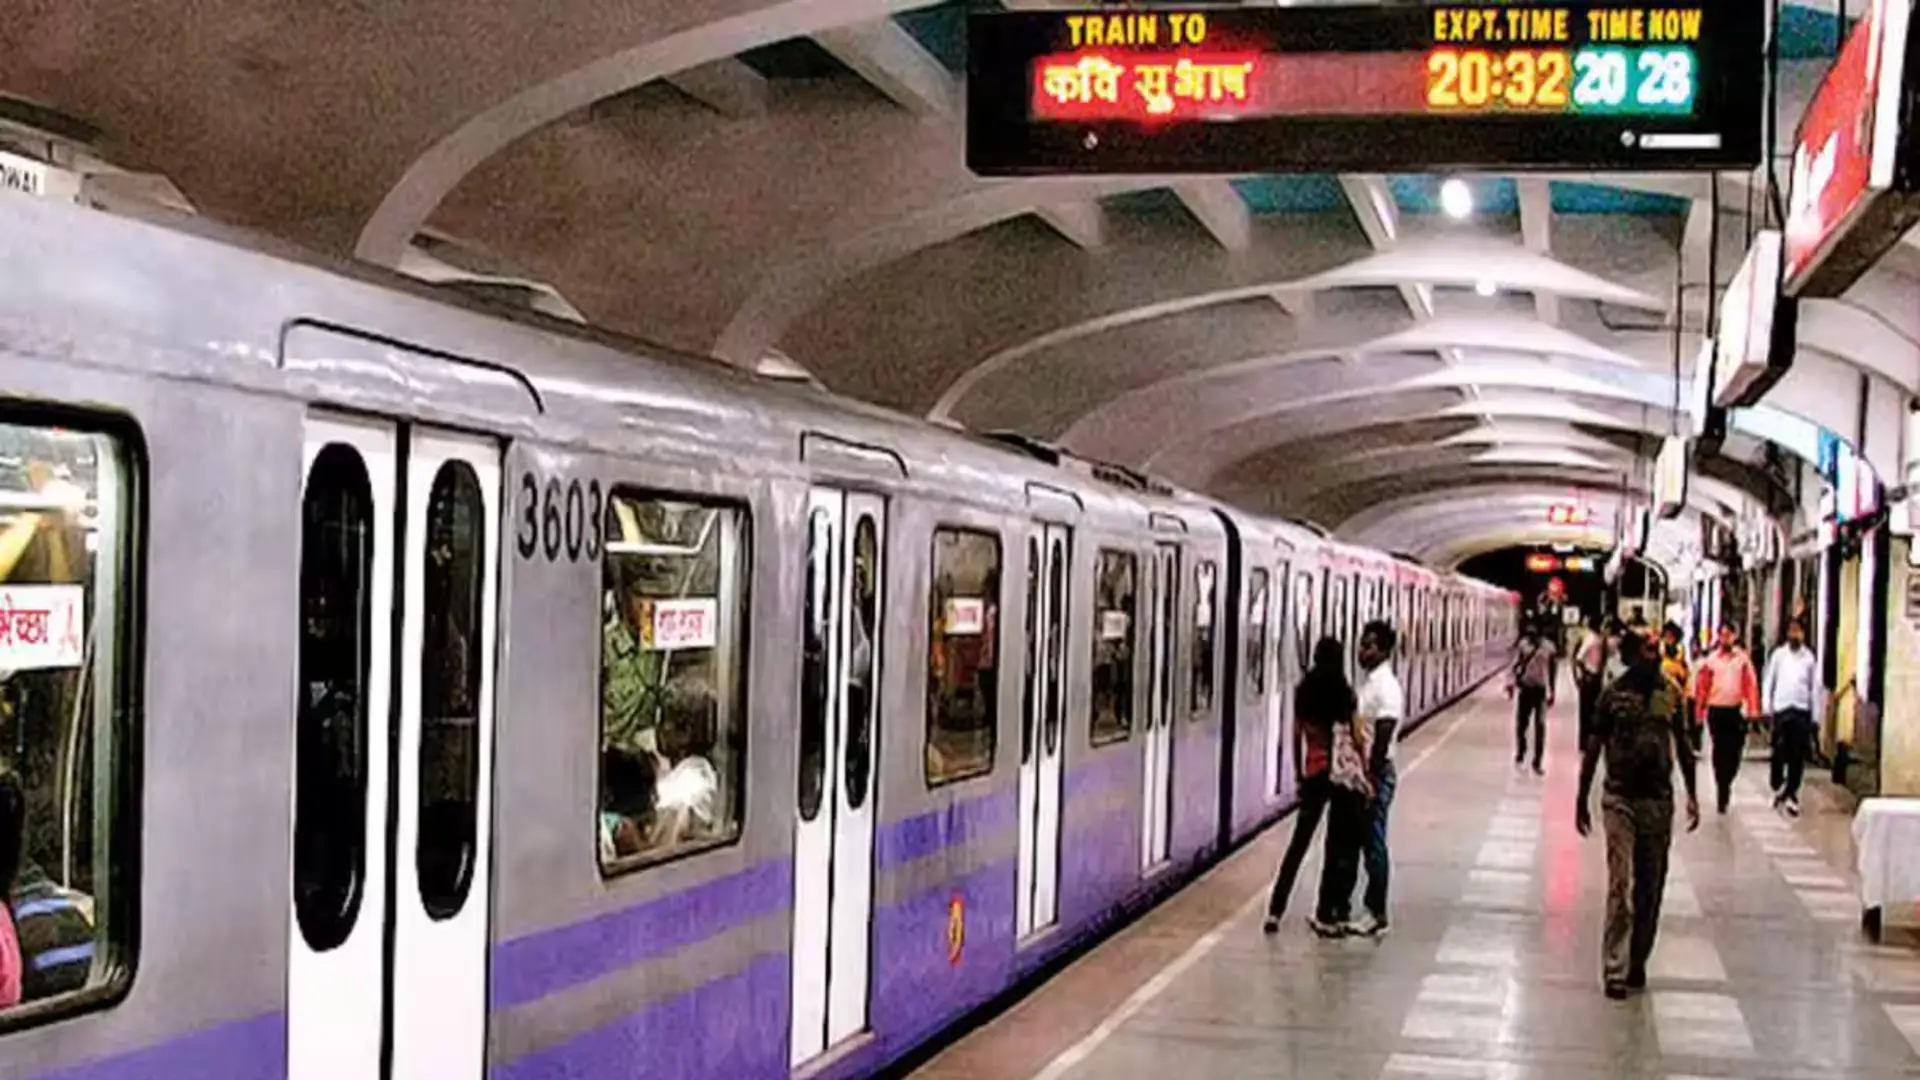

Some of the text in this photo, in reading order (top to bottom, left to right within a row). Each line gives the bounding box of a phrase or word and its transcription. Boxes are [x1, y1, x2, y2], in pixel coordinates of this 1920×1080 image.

[1066, 13, 1207, 46] TRAIN TO
[1507, 9, 1570, 40] TIME
[1588, 9, 1702, 41] TIME NOW
[1427, 51, 1569, 106] 20:32
[518, 471, 602, 563] 3603
